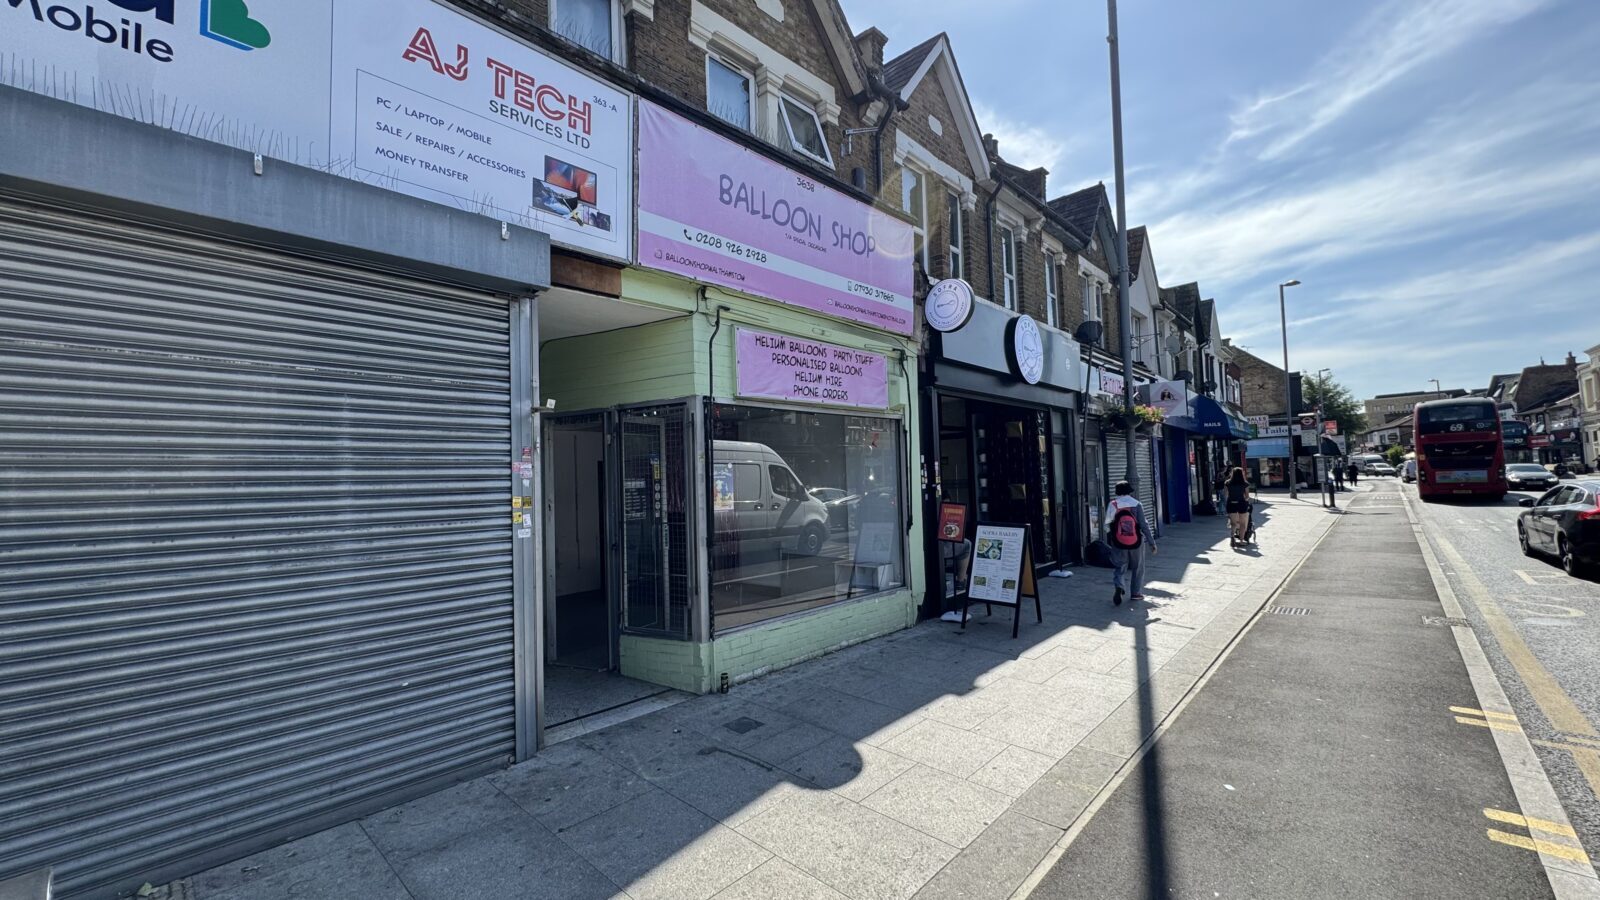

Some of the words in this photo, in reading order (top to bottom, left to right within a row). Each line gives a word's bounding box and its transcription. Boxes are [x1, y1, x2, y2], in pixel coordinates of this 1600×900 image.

[402, 27, 469, 82] AJ
[486, 57, 592, 136] TECH
[592, 95, 607, 108] 363
[376, 96, 392, 109] PC
[404, 106, 445, 128] LAPTOP
[456, 126, 492, 145] MOBILE
[489, 99, 562, 139] SERVICES
[566, 130, 591, 150] LTD
[375, 146, 417, 166] MONEY
[418, 159, 469, 182] TRANSFER
[376, 121, 402, 137] SALE
[415, 134, 456, 155] REPAIRS
[466, 153, 526, 178] ACCESSORIES
[718, 173, 822, 241] BALLOON
[831, 220, 876, 258] SHOP
[696, 232, 722, 248] 0208
[725, 242, 743, 255] 926
[746, 248, 767, 263] 2928
[665, 252, 746, 281] BALLOONSHOPWALTHAMSTOW
[854, 283, 874, 296] 07930
[933, 284, 958, 297] SOFRA
[755, 335, 786, 350] HELIUM
[789, 341, 828, 358] BALLOONS
[833, 349, 853, 362] PARTY
[855, 353, 874, 366] STUFF
[771, 352, 827, 371] PERSONALISED
[829, 362, 863, 377] BALLOONS
[793, 384, 819, 398] PHONE
[822, 388, 849, 401] ORDERS
[795, 371, 823, 384] HELIUM
[825, 374, 843, 387] HIRE
